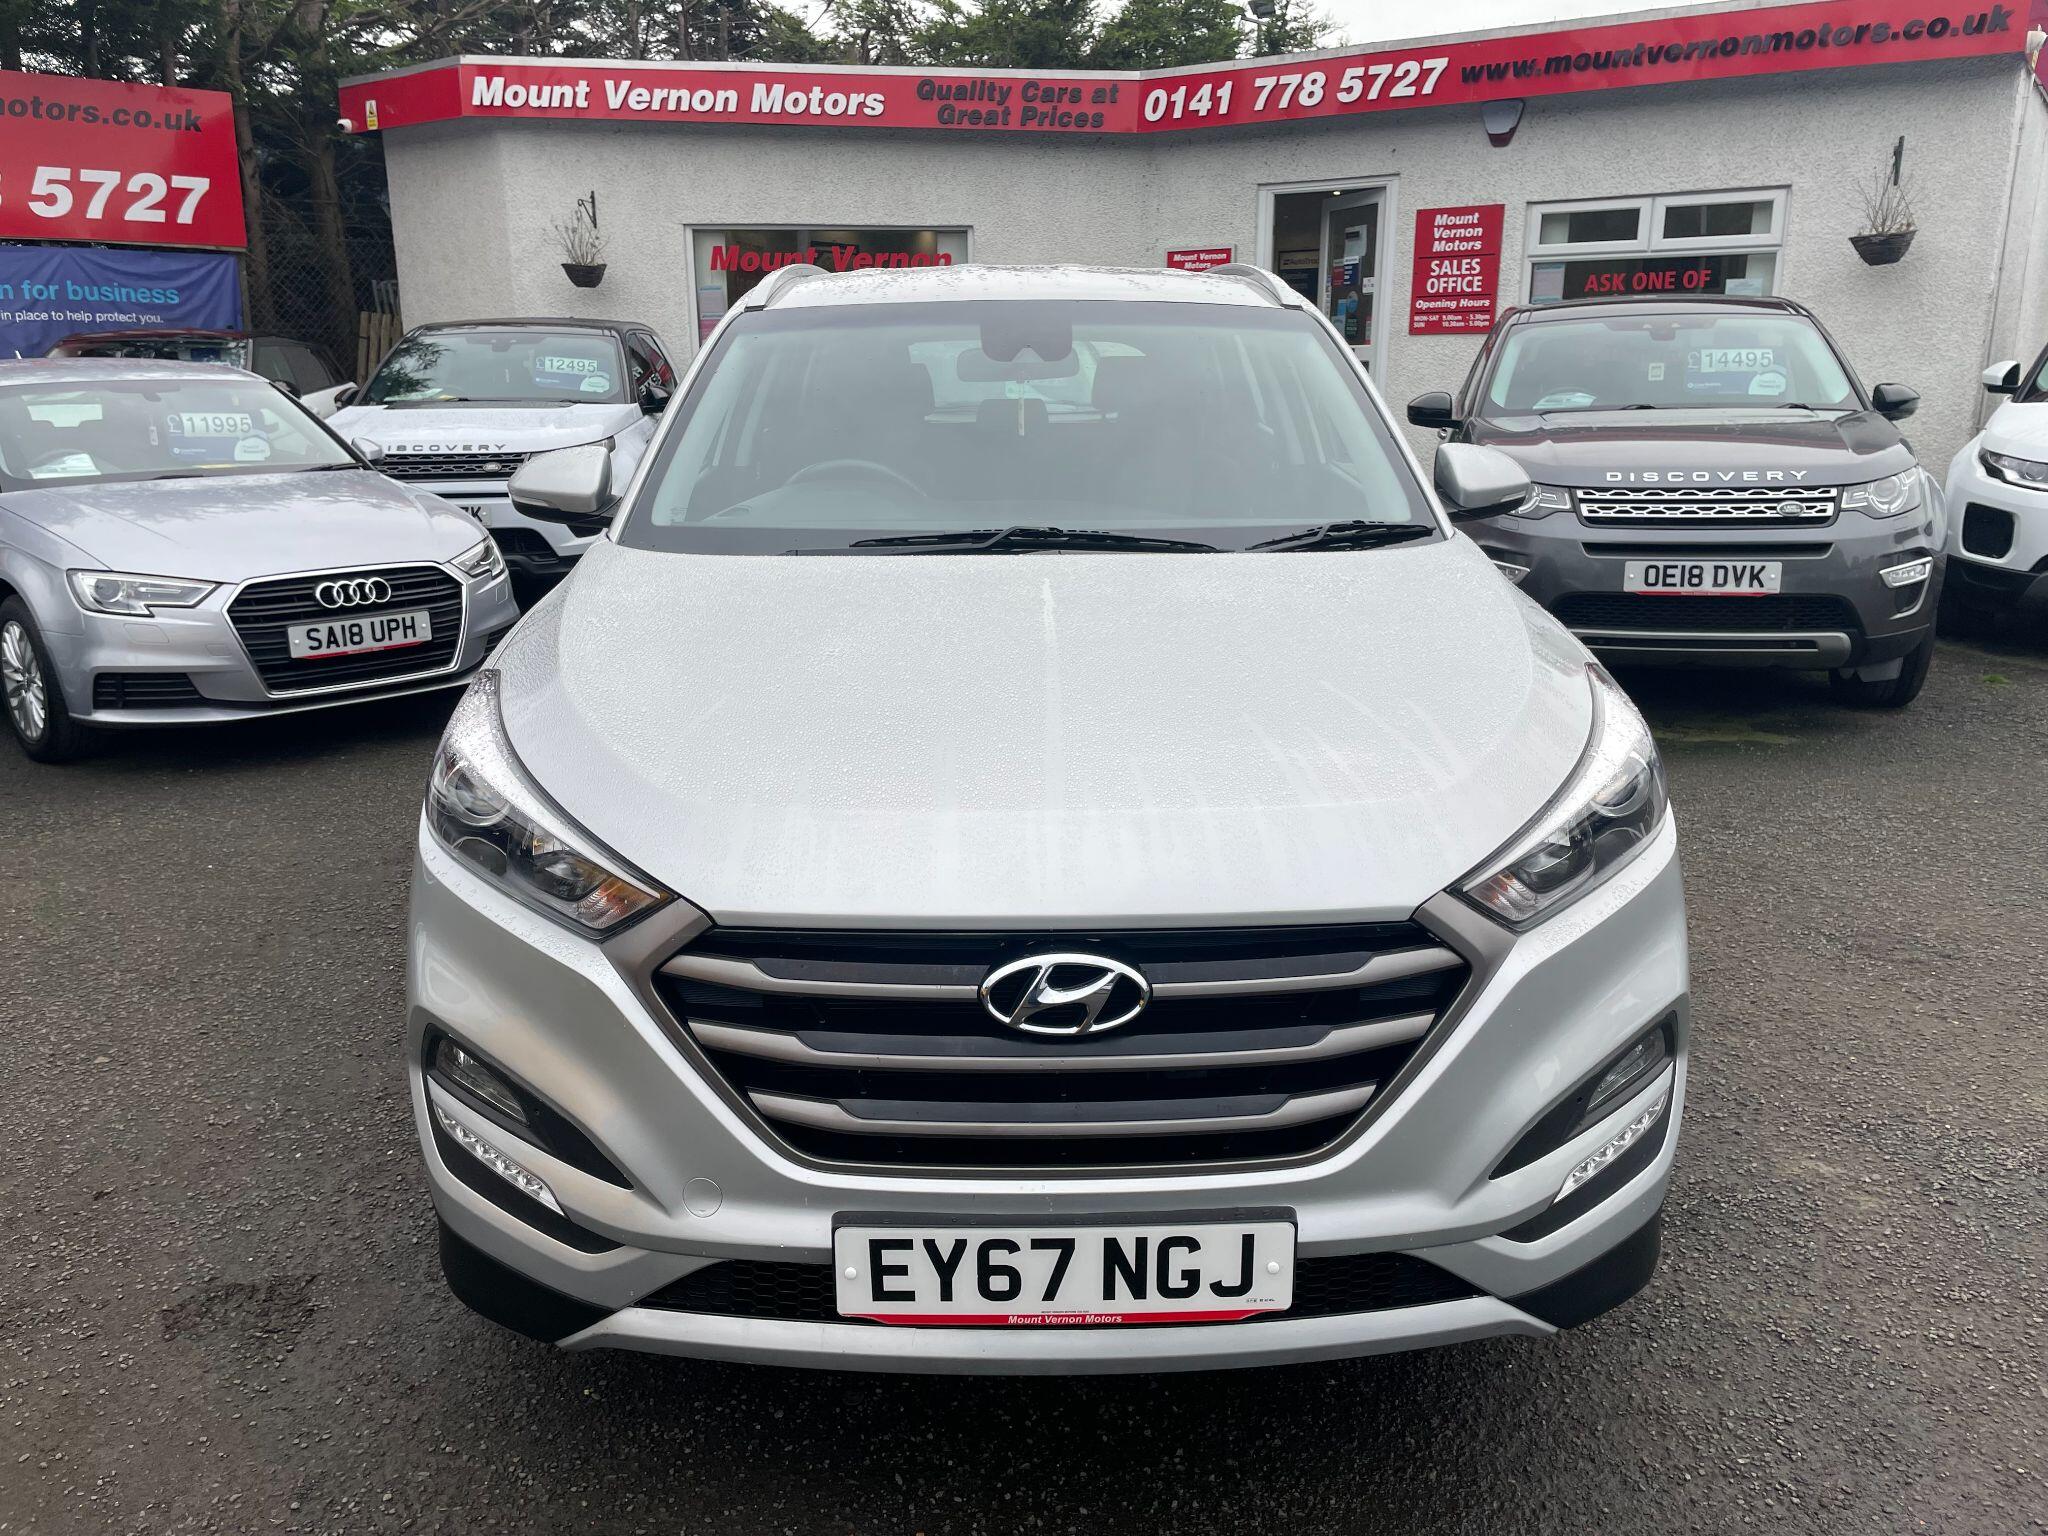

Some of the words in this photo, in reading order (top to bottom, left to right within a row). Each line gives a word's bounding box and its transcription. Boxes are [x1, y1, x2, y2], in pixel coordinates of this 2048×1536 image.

[1461, 5, 2015, 84] www.mountvernonmotors.co.uk
[471, 76, 591, 108] Mount
[604, 79, 738, 112] Vernon
[750, 82, 885, 116] Motors
[916, 78, 1012, 105] Quality
[1021, 80, 1082, 104] Cars
[1091, 83, 1119, 104] at
[1143, 80, 1233, 122] 0141
[1253, 71, 1327, 111] 778
[1336, 57, 1449, 103] 5727
[0, 96, 202, 132] otors.co.uk
[937, 103, 1012, 126] Great
[1020, 105, 1104, 128] Prices
[28, 166, 210, 224] 5727
[1434, 212, 1480, 226] Mount
[1433, 226, 1483, 239] Vernon
[1173, 253, 1198, 261] Mount
[1200, 253, 1227, 261] Vernon
[1432, 240, 1482, 252] Motors
[710, 245, 818, 272] Mount
[831, 245, 952, 272] Vernon
[1184, 261, 1211, 270] Motors
[1430, 258, 1481, 276] SALES
[21, 279, 59, 300] for
[66, 279, 180, 304] business
[1426, 276, 1483, 293] OFFICE
[1584, 272, 1626, 292] ASK
[1632, 271, 1676, 290] ONE
[1682, 269, 1712, 289] OF
[1416, 299, 1457, 310] Opening
[1459, 298, 1490, 307] Hours
[1, 309, 12, 321] in
[15, 310, 49, 324] place
[51, 310, 64, 321] to
[67, 310, 92, 324] help
[96, 311, 137, 324] protect
[140, 314, 164, 326] you.
[388, 444, 506, 452] ISCOVERY
[1605, 470, 1808, 482] DISCOVERY
[1644, 564, 1704, 588] OE18
[1712, 565, 1766, 588] DVK
[306, 623, 364, 650] SA18
[370, 616, 417, 642] UPH
[868, 1237, 1076, 1303] EY67
[1102, 1233, 1255, 1301] NGJ
[1008, 1315, 1042, 1324] Mount
[1045, 1315, 1082, 1324] Vernon
[1085, 1314, 1122, 1323] Motors
